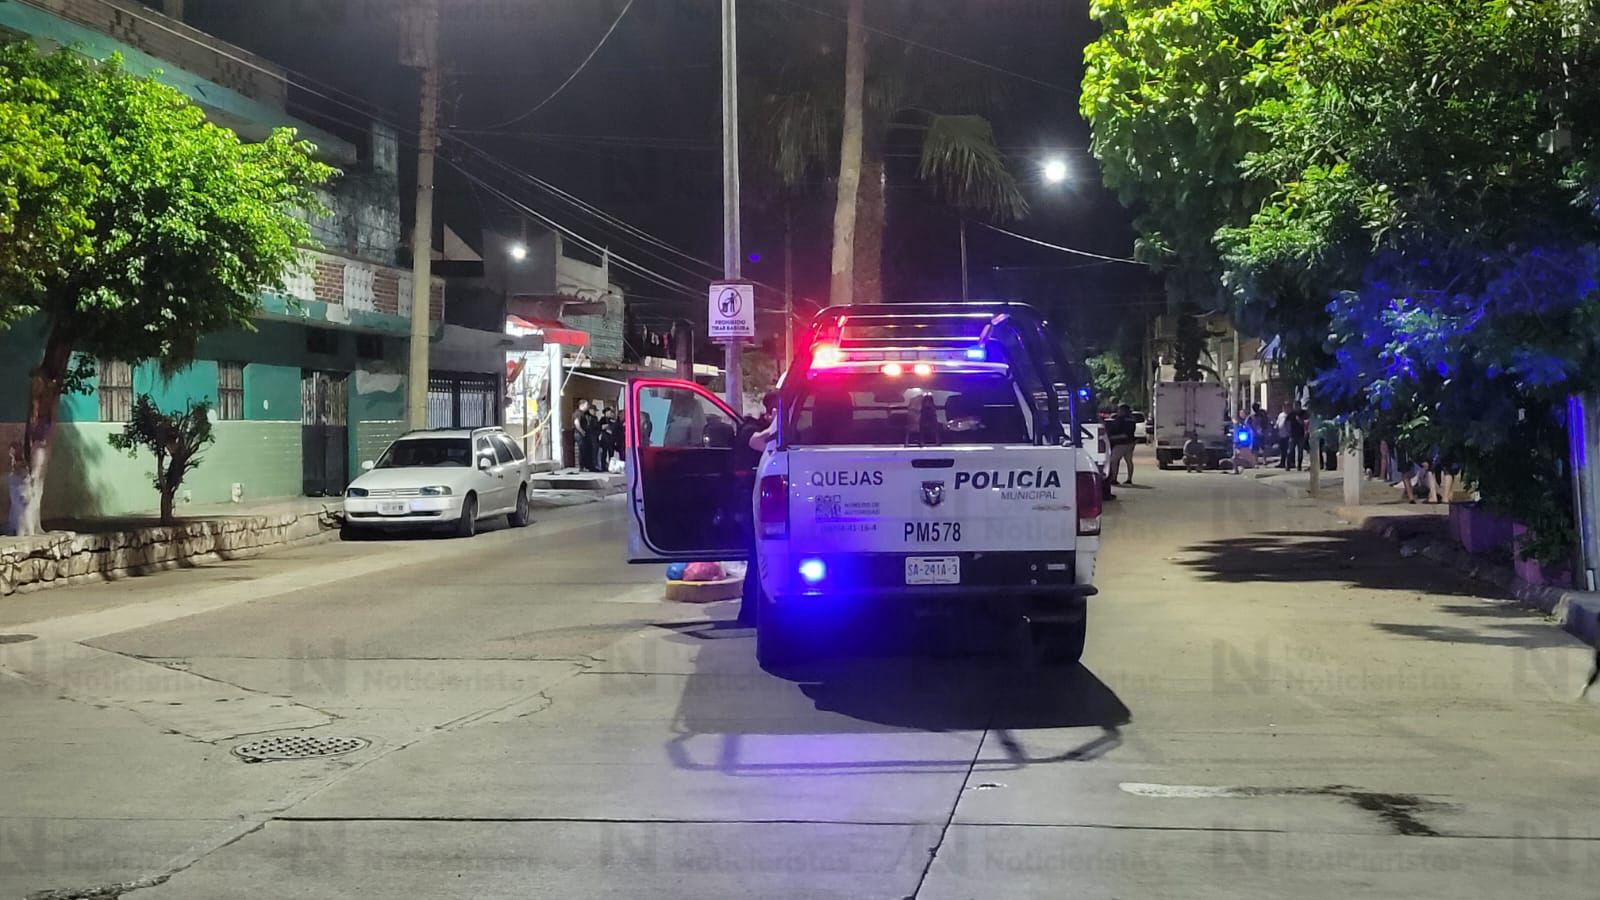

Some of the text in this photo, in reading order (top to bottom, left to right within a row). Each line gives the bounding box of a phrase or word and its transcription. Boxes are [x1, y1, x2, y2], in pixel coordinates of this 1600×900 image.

[811, 470, 884, 487] QUEJAS
[954, 466, 1061, 490] POLICÍA
[1001, 490, 1058, 500] MUNICIPAL
[904, 522, 961, 542] PM578
[908, 564, 958, 576] SA-241A-3
